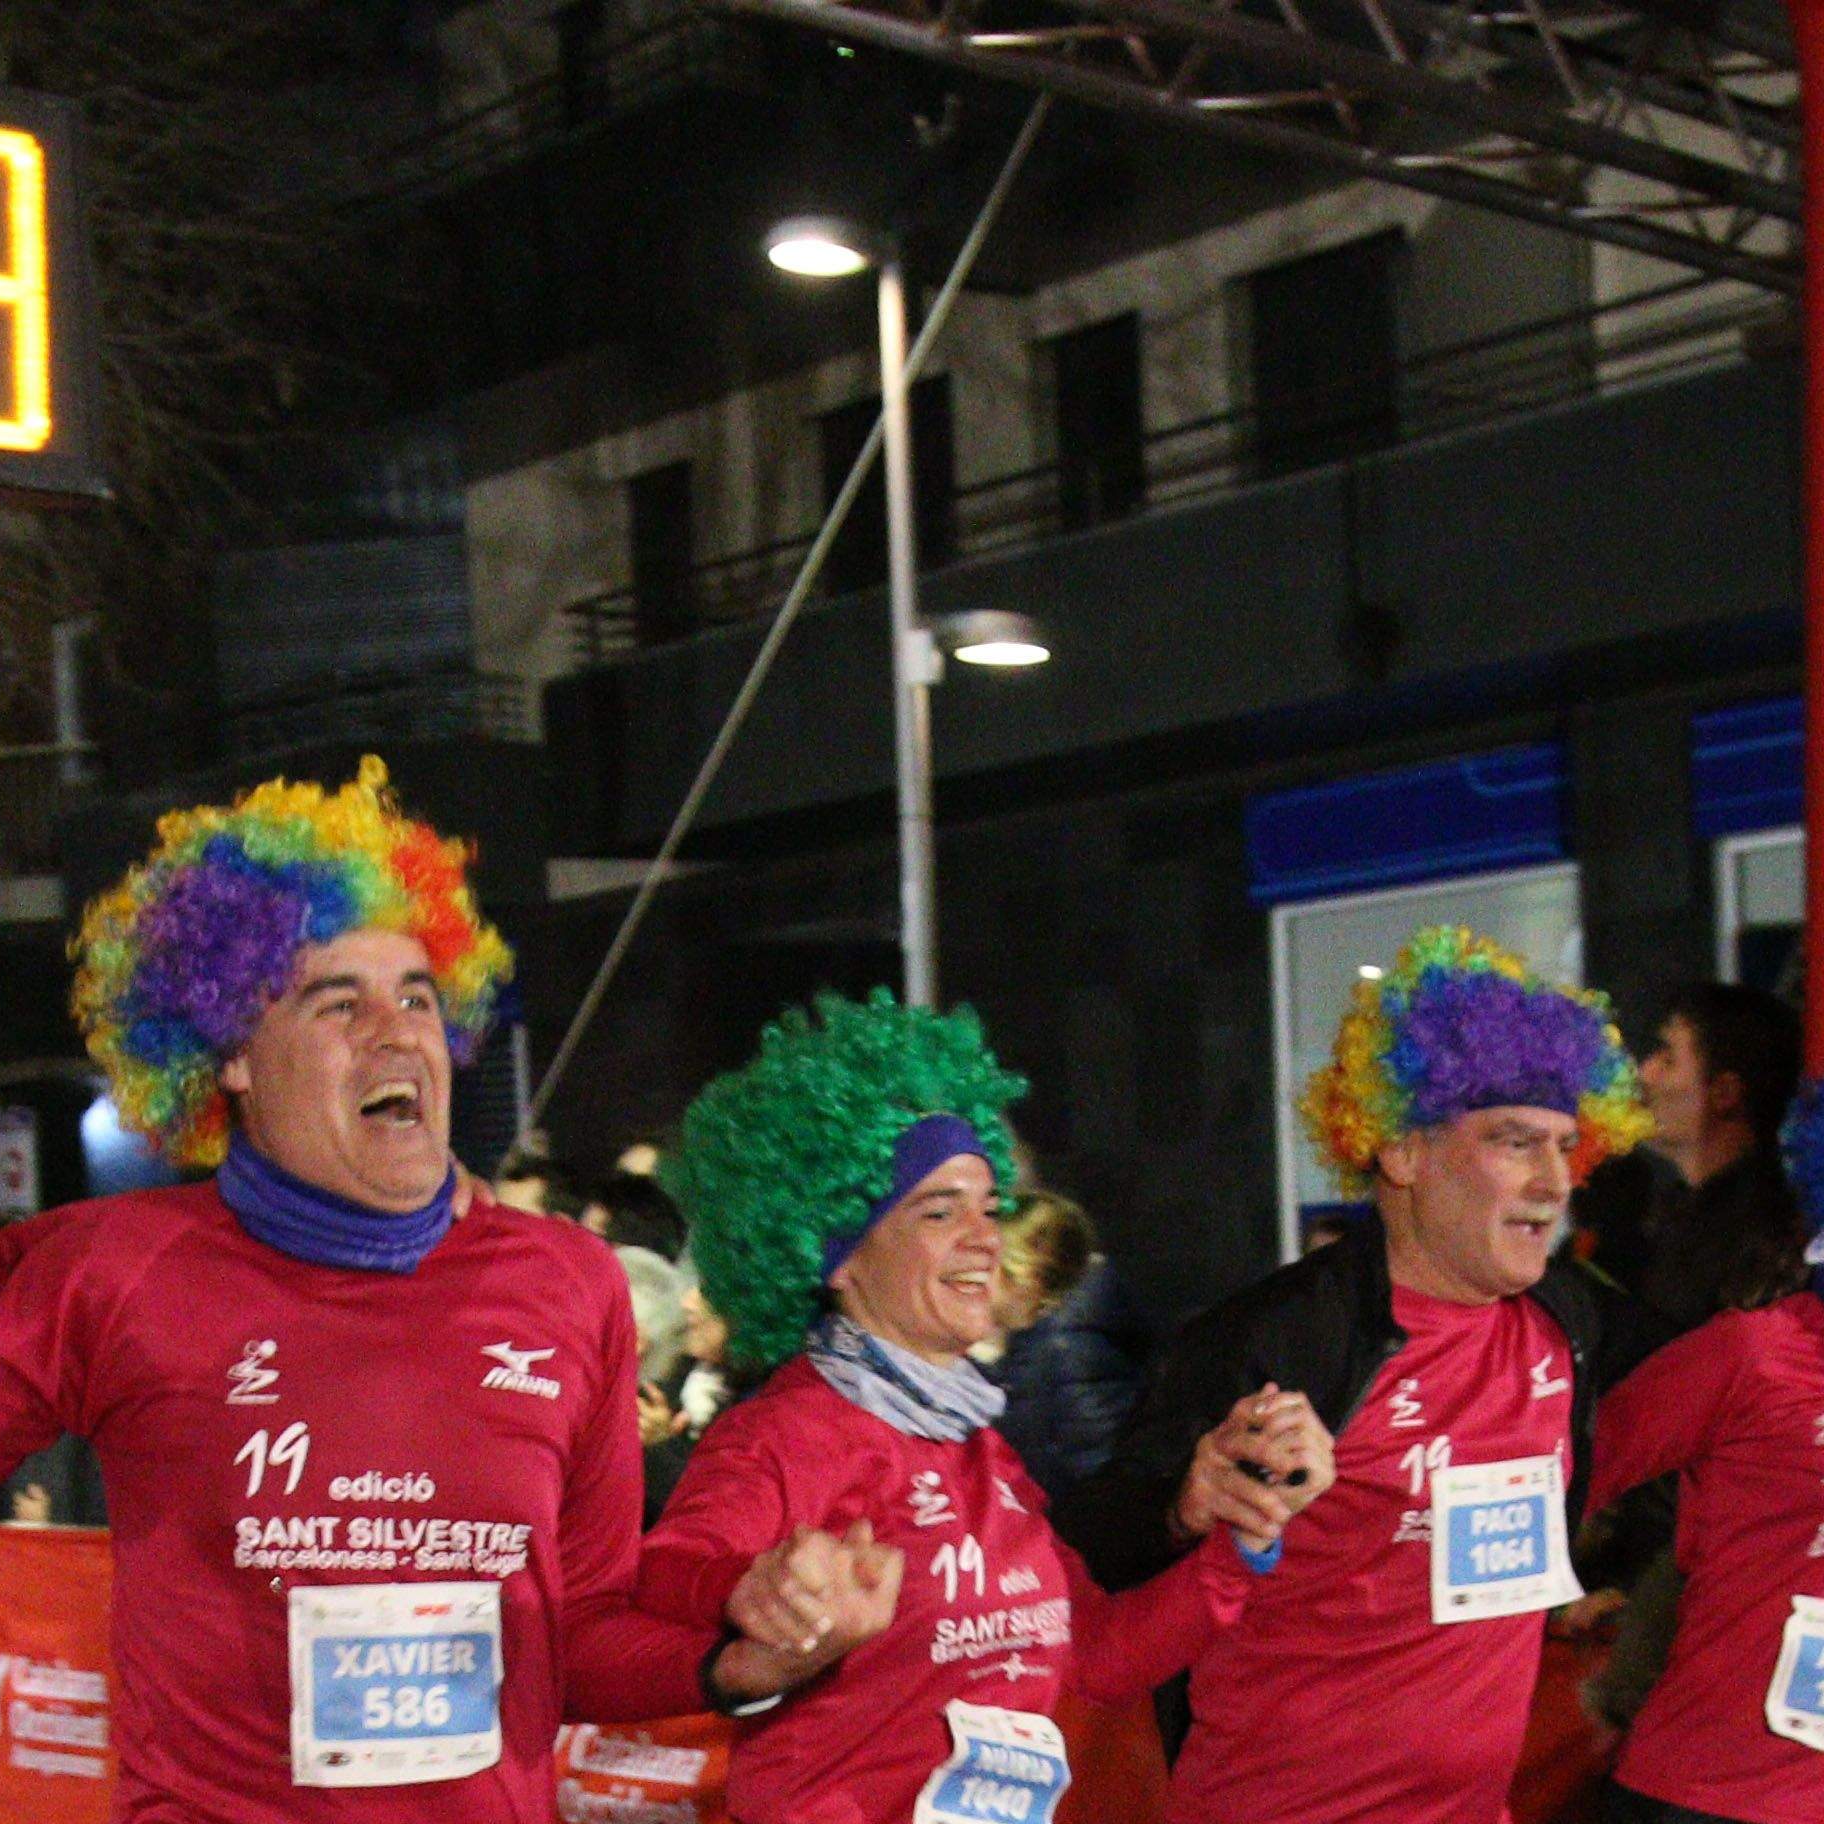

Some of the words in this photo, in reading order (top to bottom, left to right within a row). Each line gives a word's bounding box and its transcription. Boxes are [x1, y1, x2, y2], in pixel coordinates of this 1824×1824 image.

[233, 1421, 310, 1499] 19
[329, 1470, 437, 1503] edició
[234, 1515, 341, 1549] SANT
[347, 1517, 533, 1554] SILVESTRE
[1471, 1501, 1532, 1535] PACO
[929, 1532, 986, 1604] 19
[332, 1640, 476, 1680] XAVIER
[363, 1683, 452, 1730] 586
